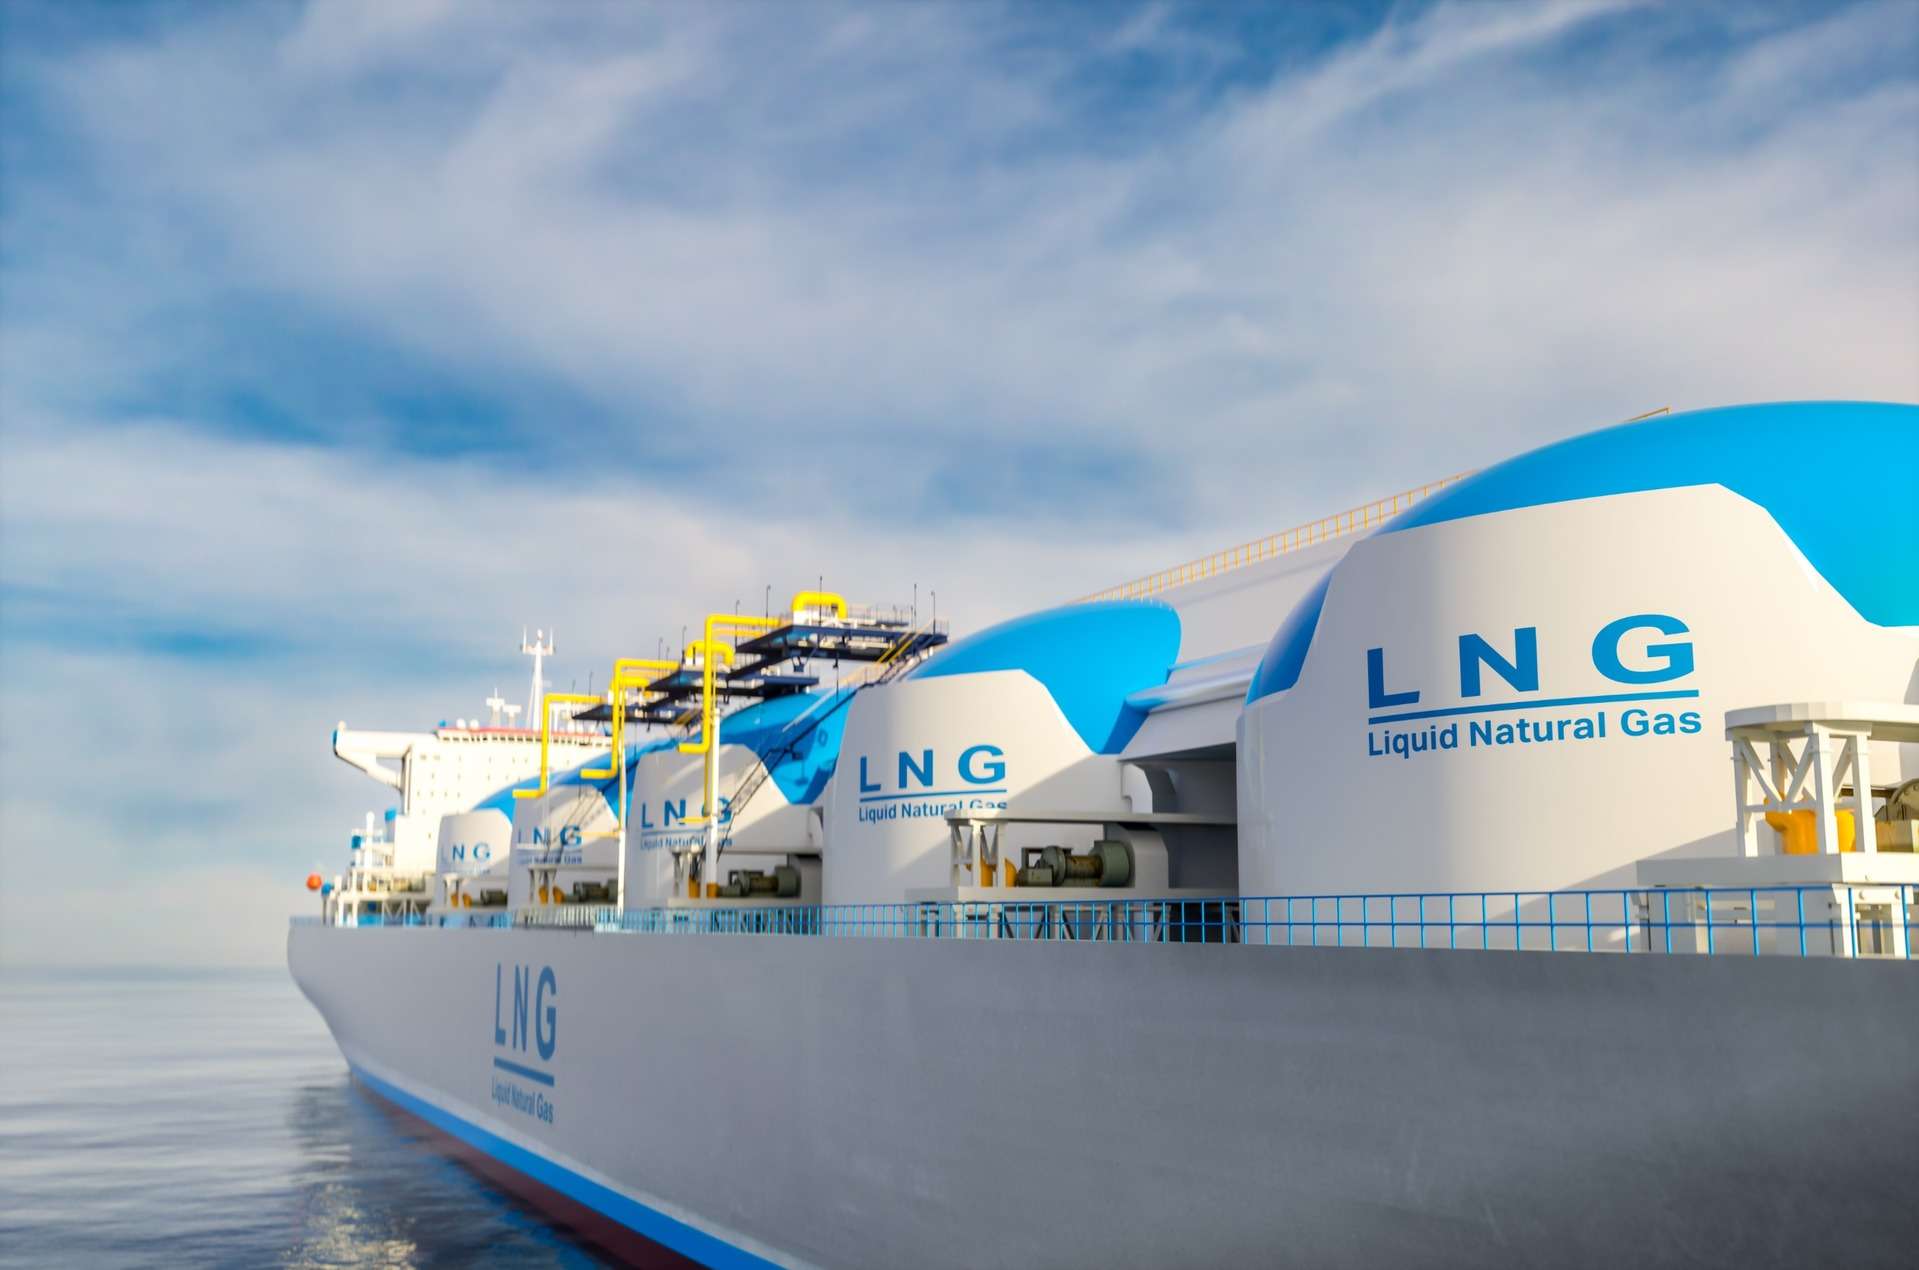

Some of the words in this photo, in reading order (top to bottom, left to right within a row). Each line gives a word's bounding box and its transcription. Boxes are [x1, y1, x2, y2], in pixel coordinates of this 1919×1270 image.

[1367, 614, 1694, 709] LNG
[1368, 723, 1458, 759] Liquid
[1470, 712, 1606, 747] Natural
[1620, 709, 1702, 737] Gas
[859, 744, 1006, 793] LNG
[858, 803, 897, 824] Liquid
[495, 963, 557, 1062] LNG
[536, 1092, 554, 1125] Gas
